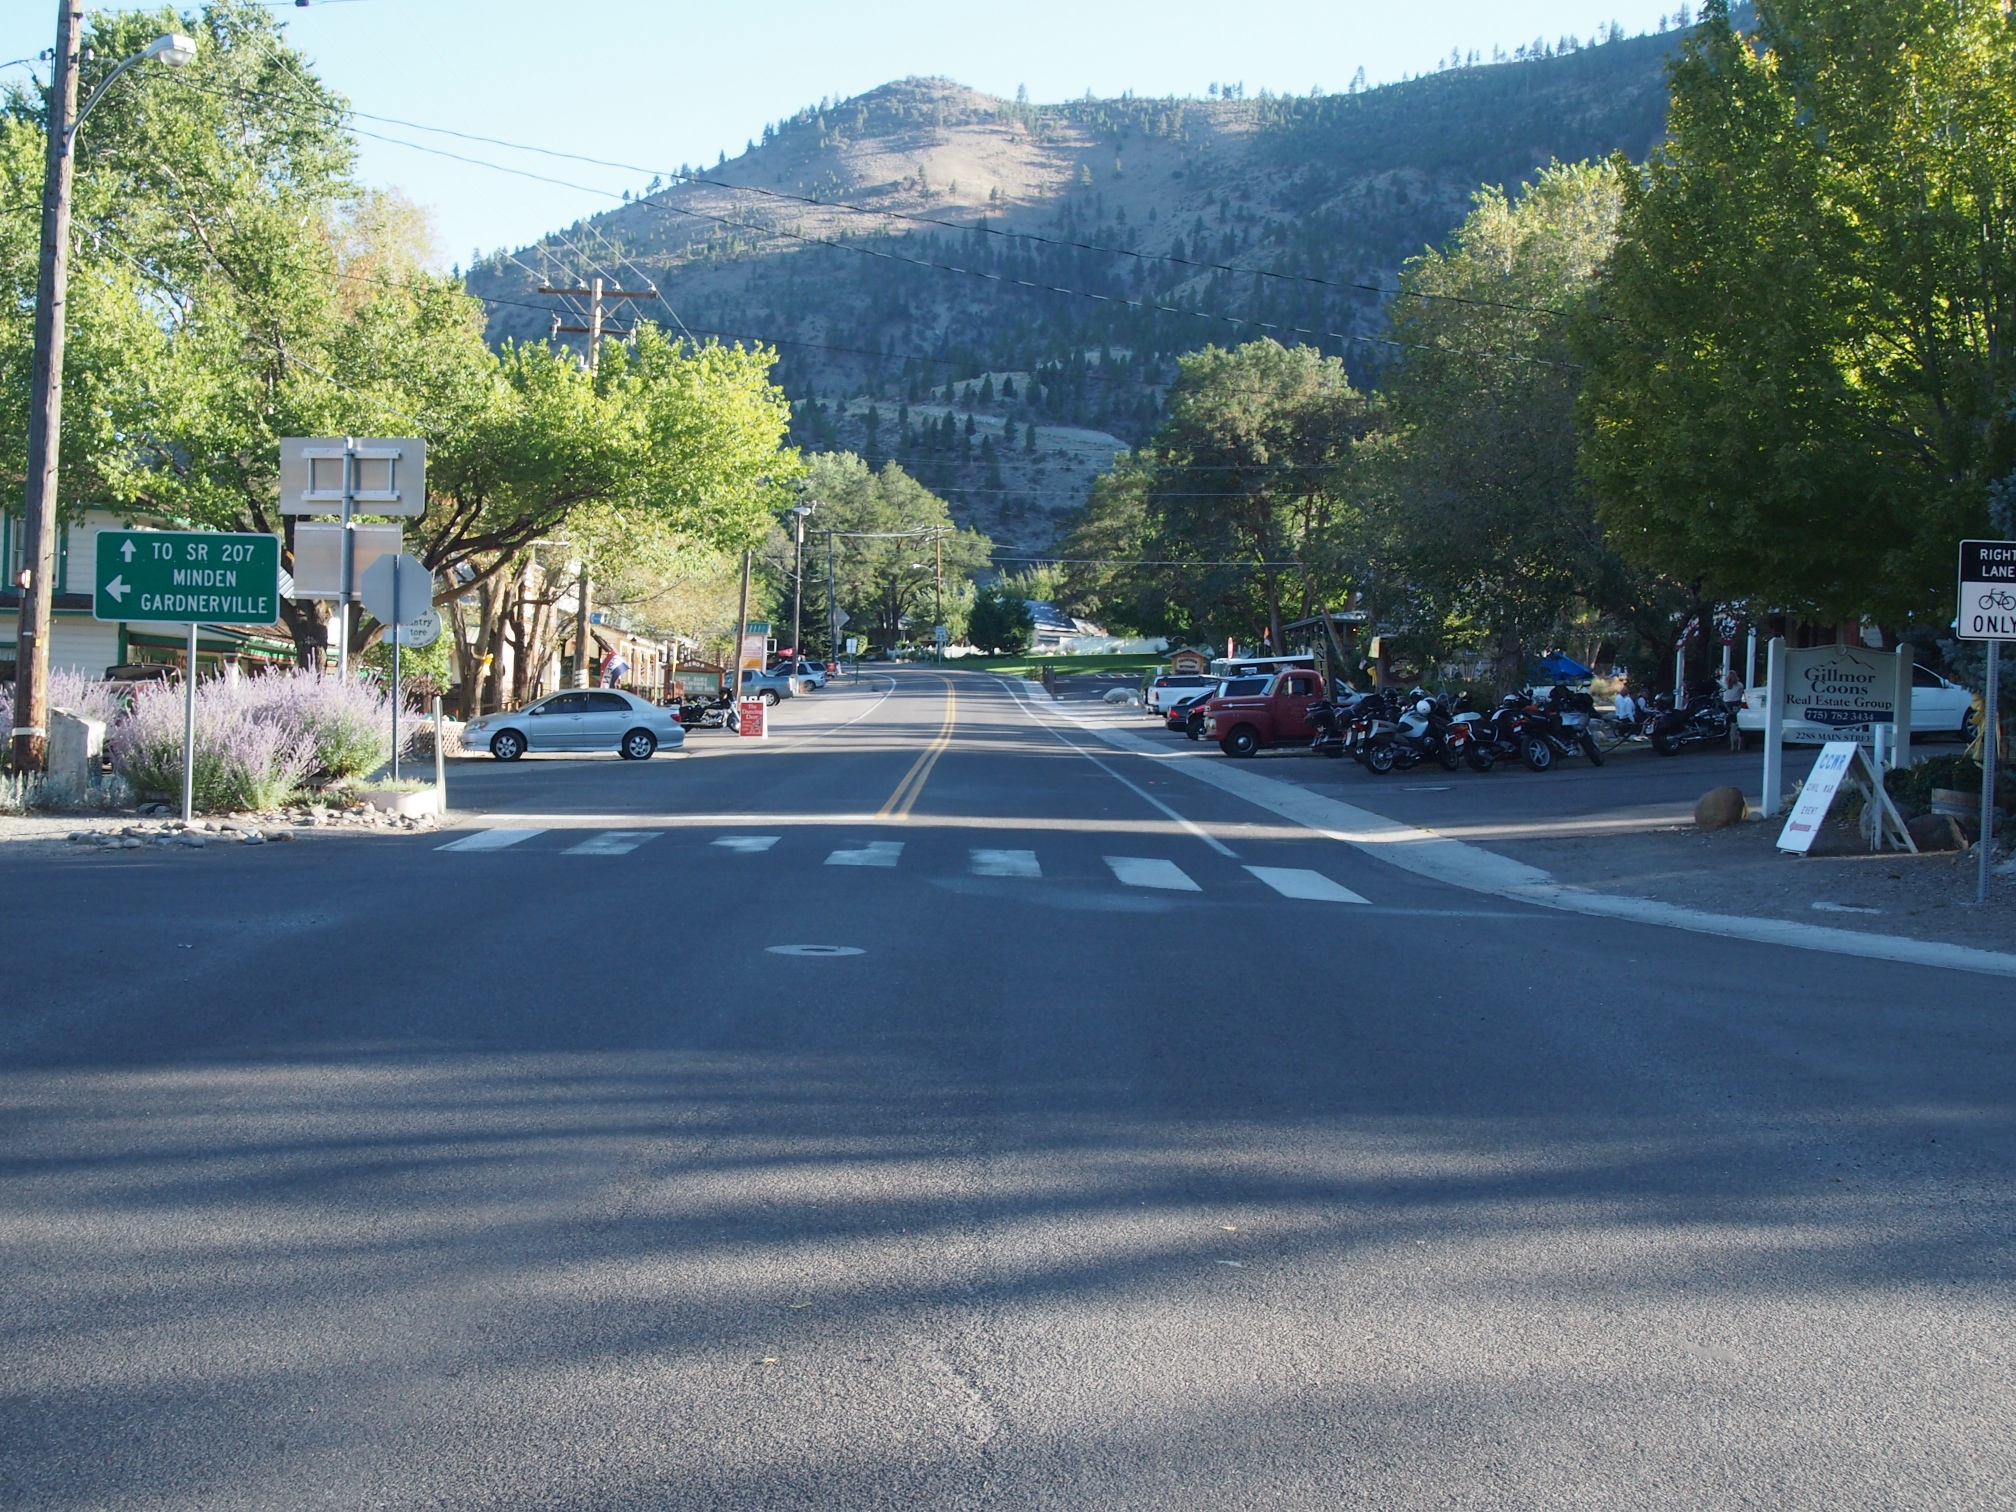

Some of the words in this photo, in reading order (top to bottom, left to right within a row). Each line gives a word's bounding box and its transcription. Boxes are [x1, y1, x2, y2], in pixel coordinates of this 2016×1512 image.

[152, 543, 172, 559] TO
[186, 544, 208, 561] SR
[222, 545, 254, 562] 207
[1980, 549, 2016, 561] RIGHT
[173, 569, 236, 587] MINDEN
[1982, 565, 2015, 577] LANE
[141, 594, 267, 614] GARDNERVILLE
[1973, 615, 2016, 633] ONLY
[1804, 668, 1876, 684] Gillmor
[1811, 680, 1868, 695] Coons
[1786, 694, 1811, 705] Real
[1815, 696, 1850, 707] Estate
[1854, 697, 1892, 710] Group
[1831, 711, 1847, 720] 782
[1850, 712, 1874, 721] 3434
[1796, 732, 1815, 740] 2288
[1818, 733, 1840, 741] MAIN
[1823, 784, 1835, 793] WAR
[1801, 805, 1818, 815] EVENT
